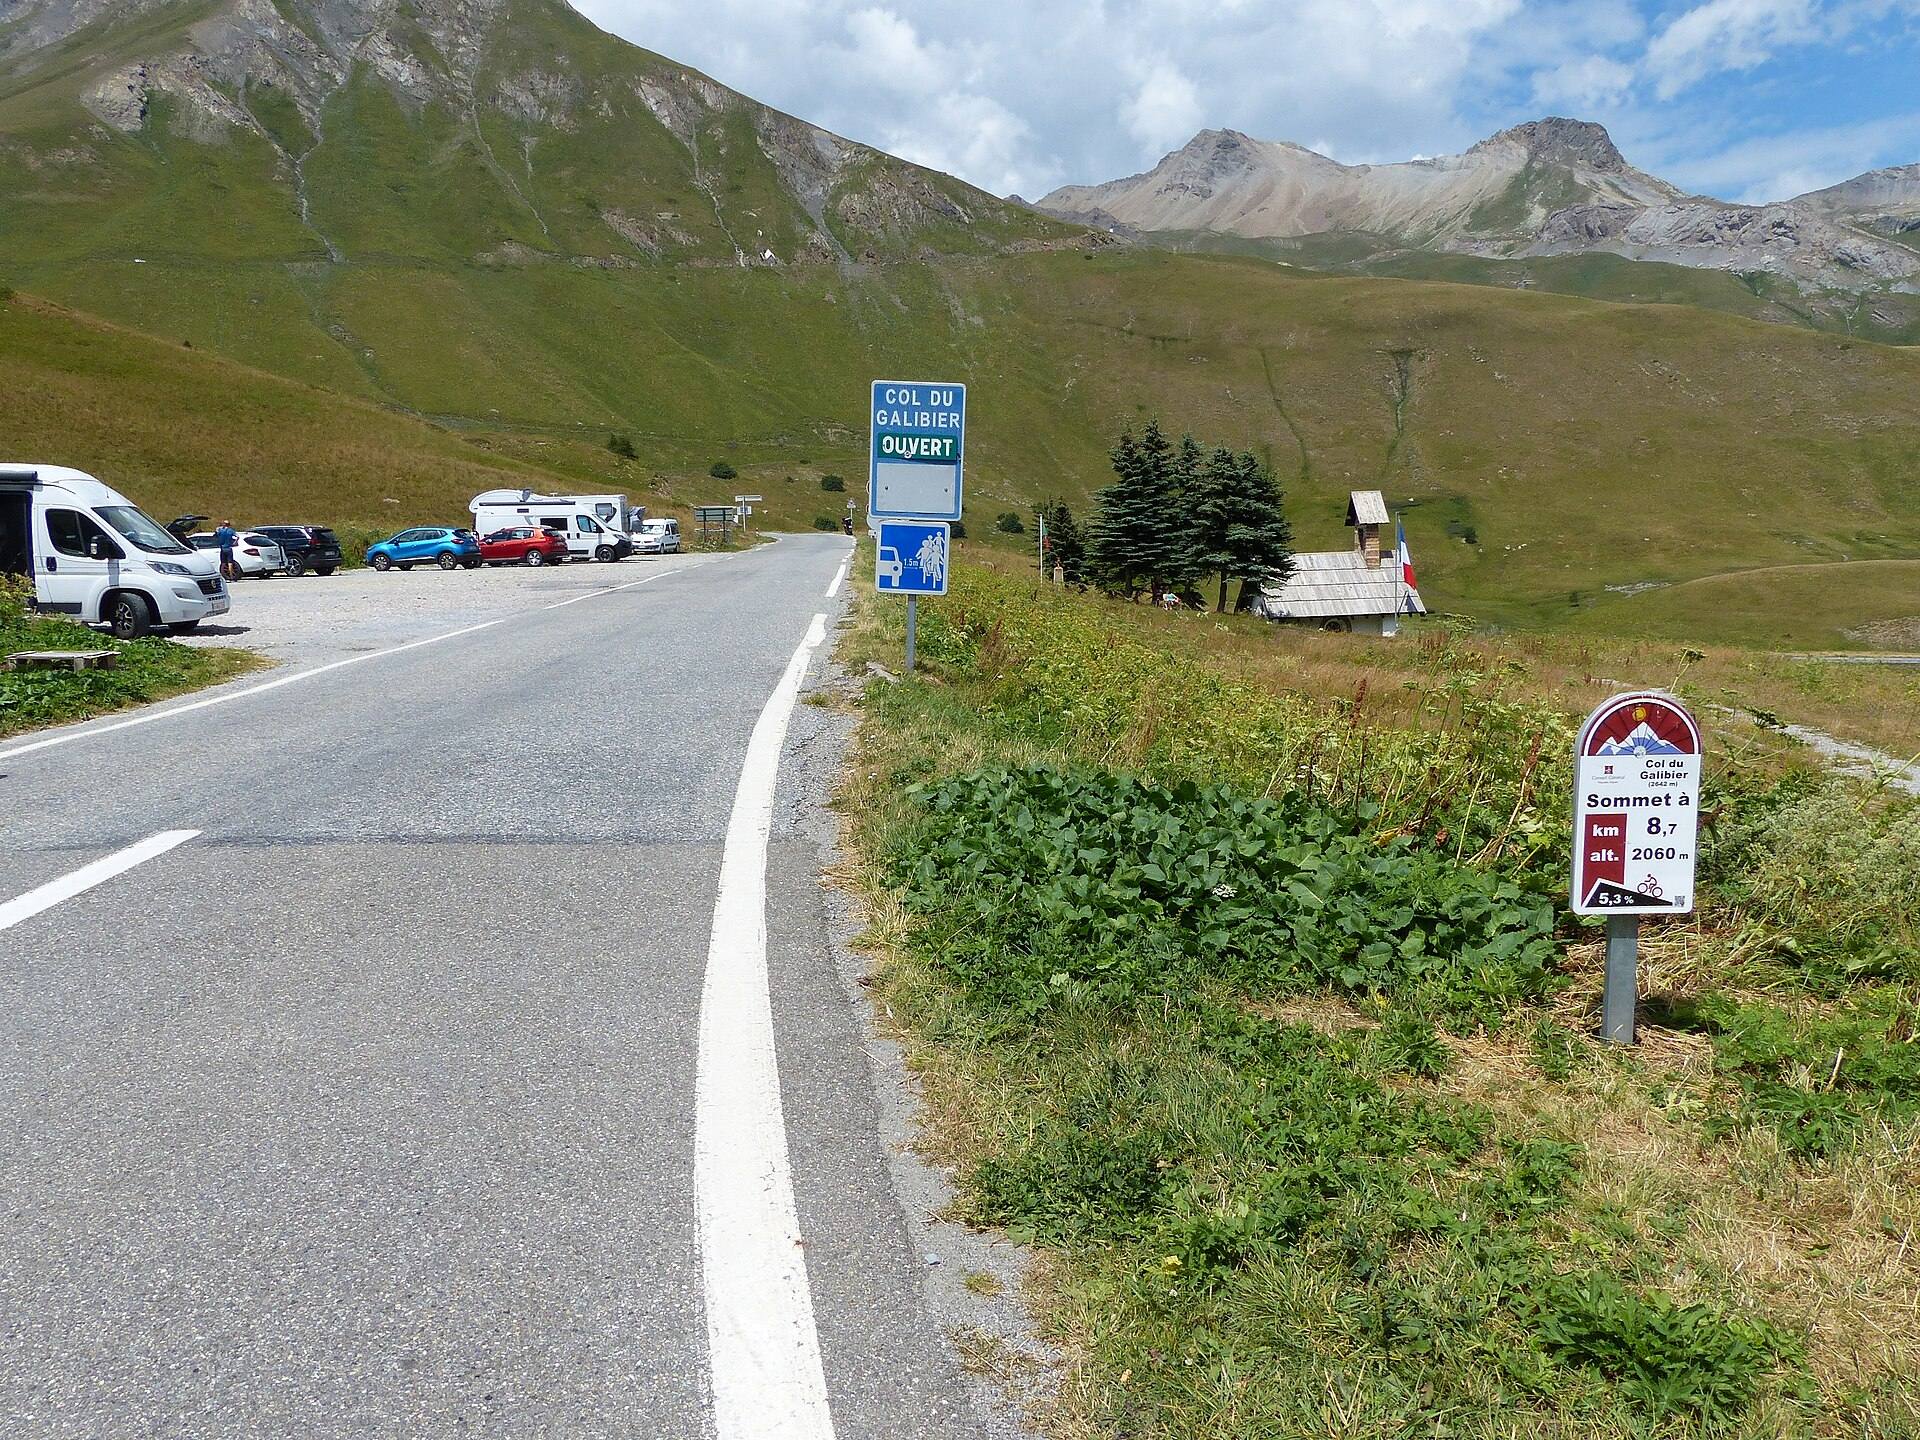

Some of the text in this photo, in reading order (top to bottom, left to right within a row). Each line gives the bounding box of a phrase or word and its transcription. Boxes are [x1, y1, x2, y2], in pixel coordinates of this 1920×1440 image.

[885, 388, 953, 407] COL DU
[876, 409, 960, 428] GALIBIER
[882, 435, 953, 457] OUVERT
[1645, 759, 1684, 768] Col du
[1640, 770, 1689, 780] Galibier
[1586, 792, 1690, 808] Sommet à
[1592, 816, 1677, 837] km 8,7
[1590, 848, 1619, 862] alt.
[1631, 847, 1676, 861] 2060
[1598, 892, 1635, 906] 5,3 %
